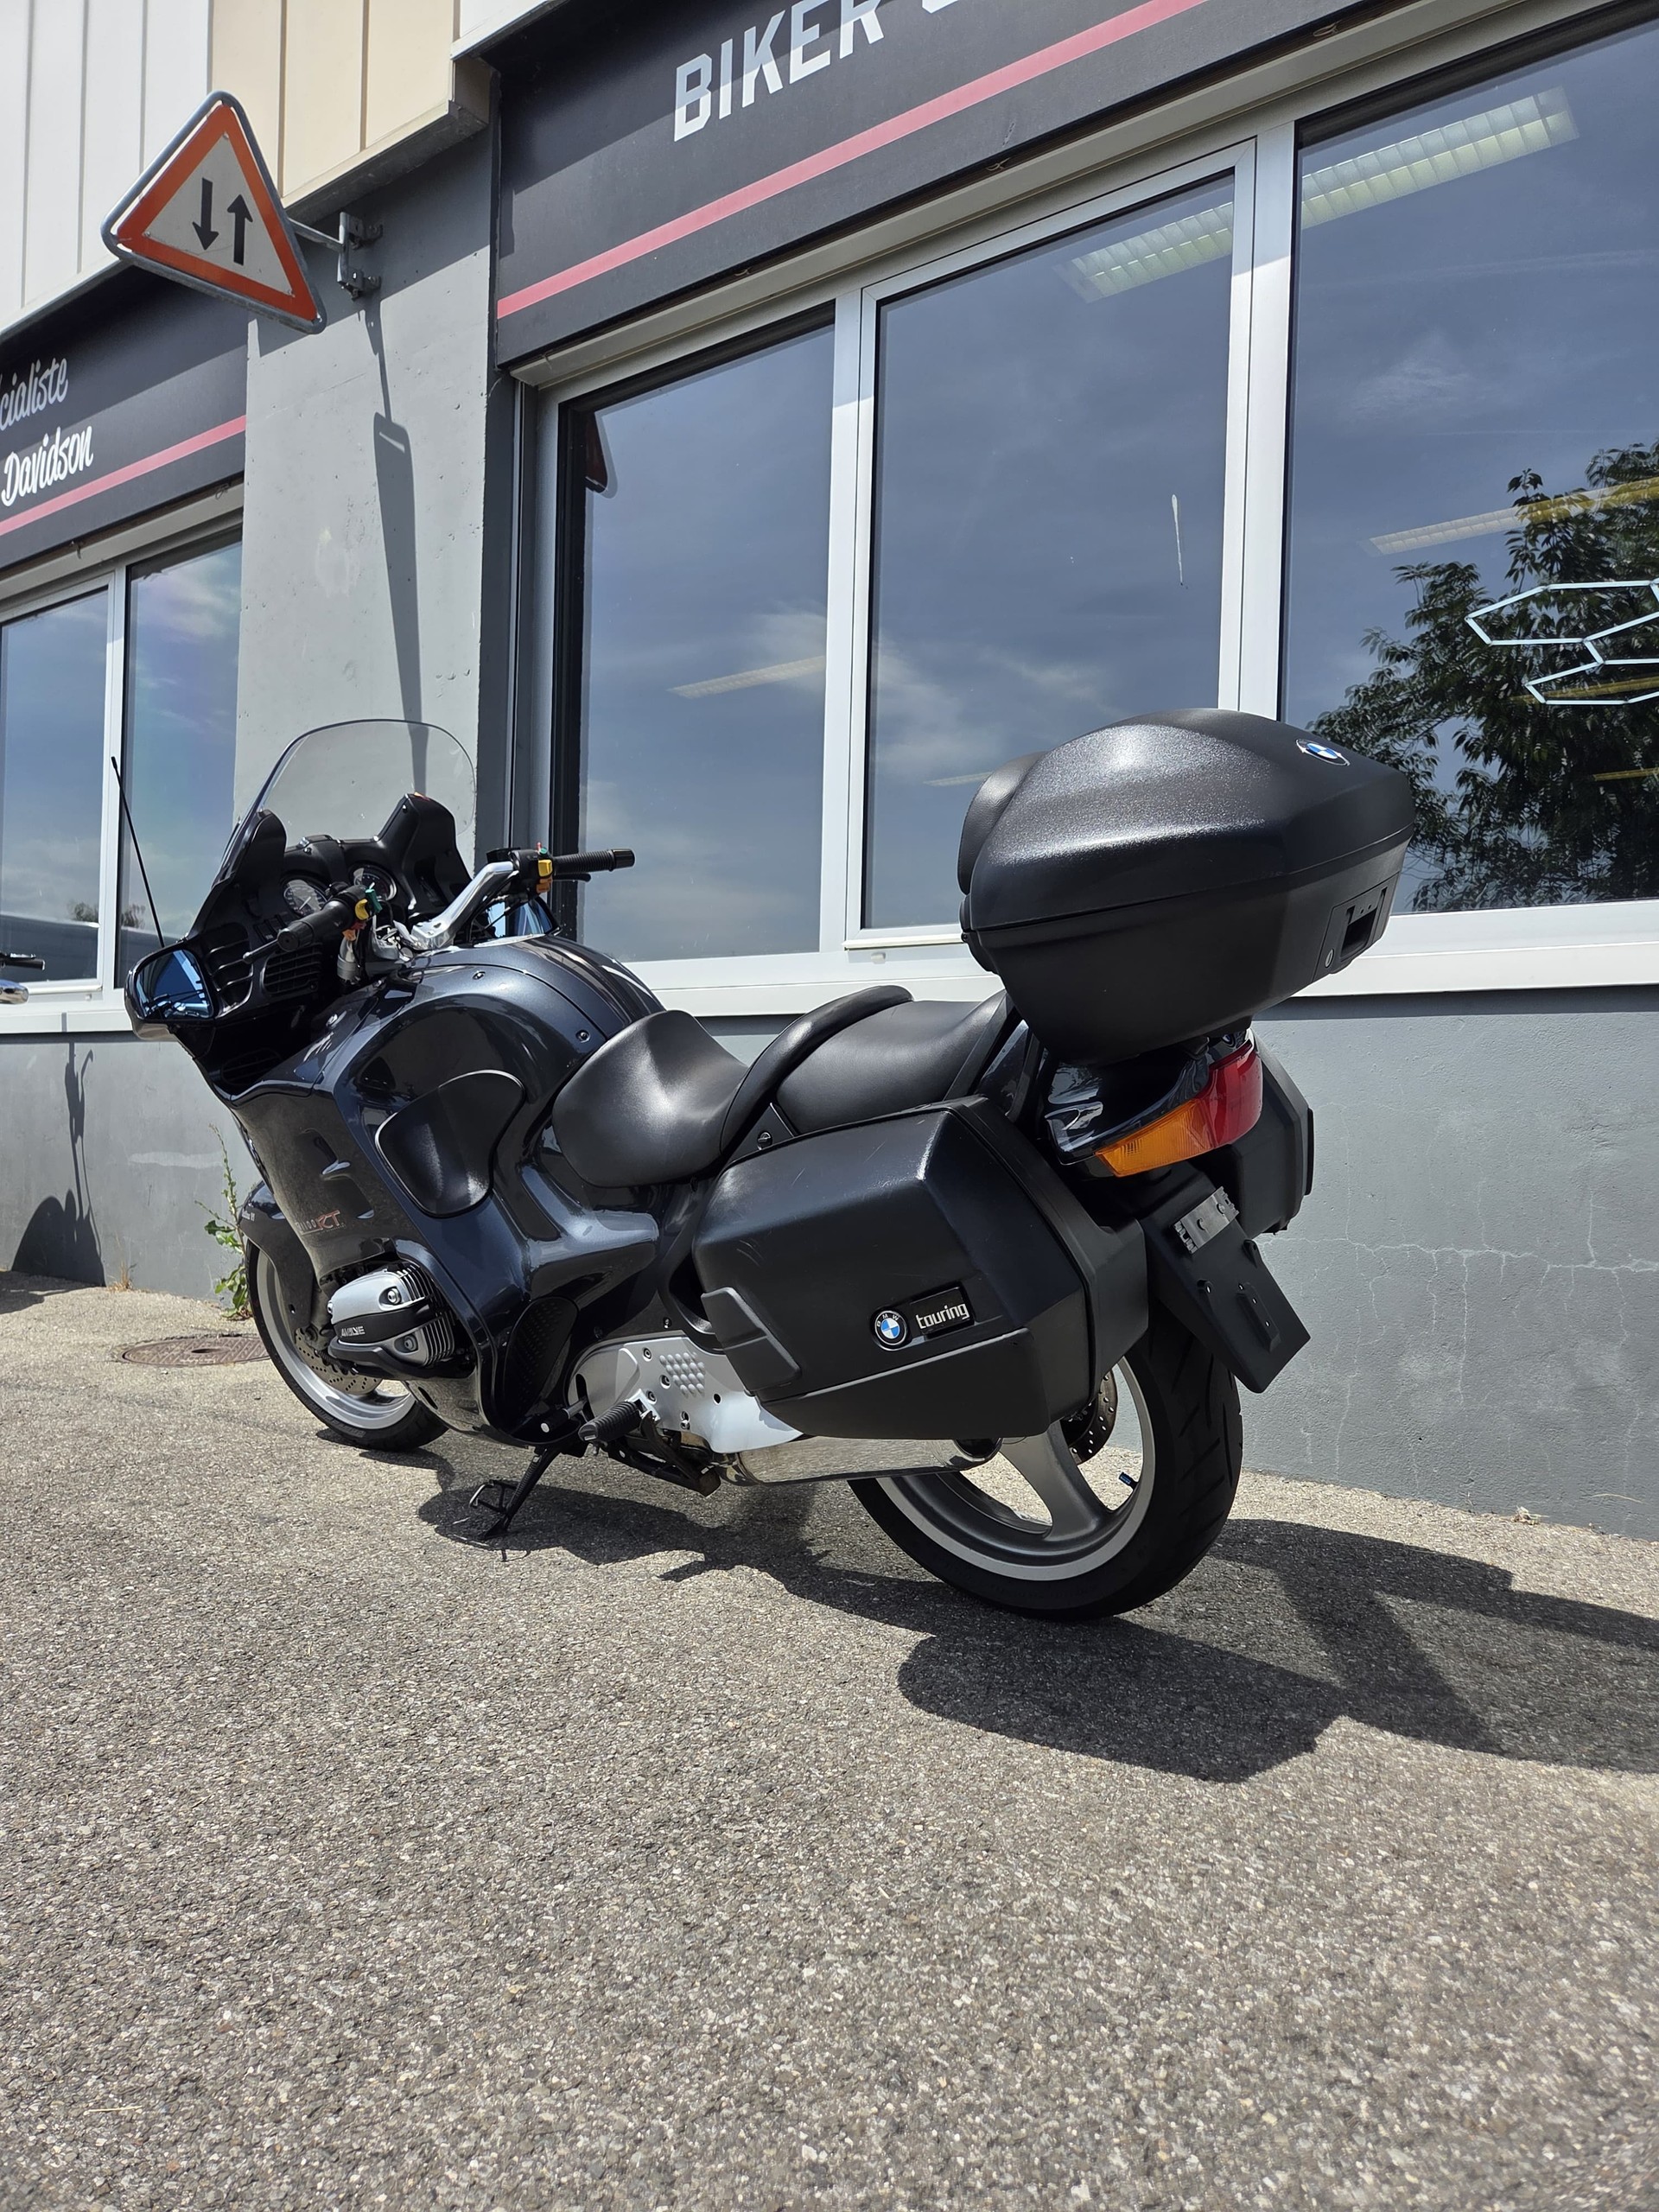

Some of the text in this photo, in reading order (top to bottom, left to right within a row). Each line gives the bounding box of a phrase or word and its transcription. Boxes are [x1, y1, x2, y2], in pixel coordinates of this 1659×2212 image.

[674, 0, 884, 142] BIKER
[0, 357, 68, 431] cialiste
[1, 426, 93, 507] Davidson
[876, 1313, 899, 1327] BMW
[916, 1303, 969, 1329] touring
